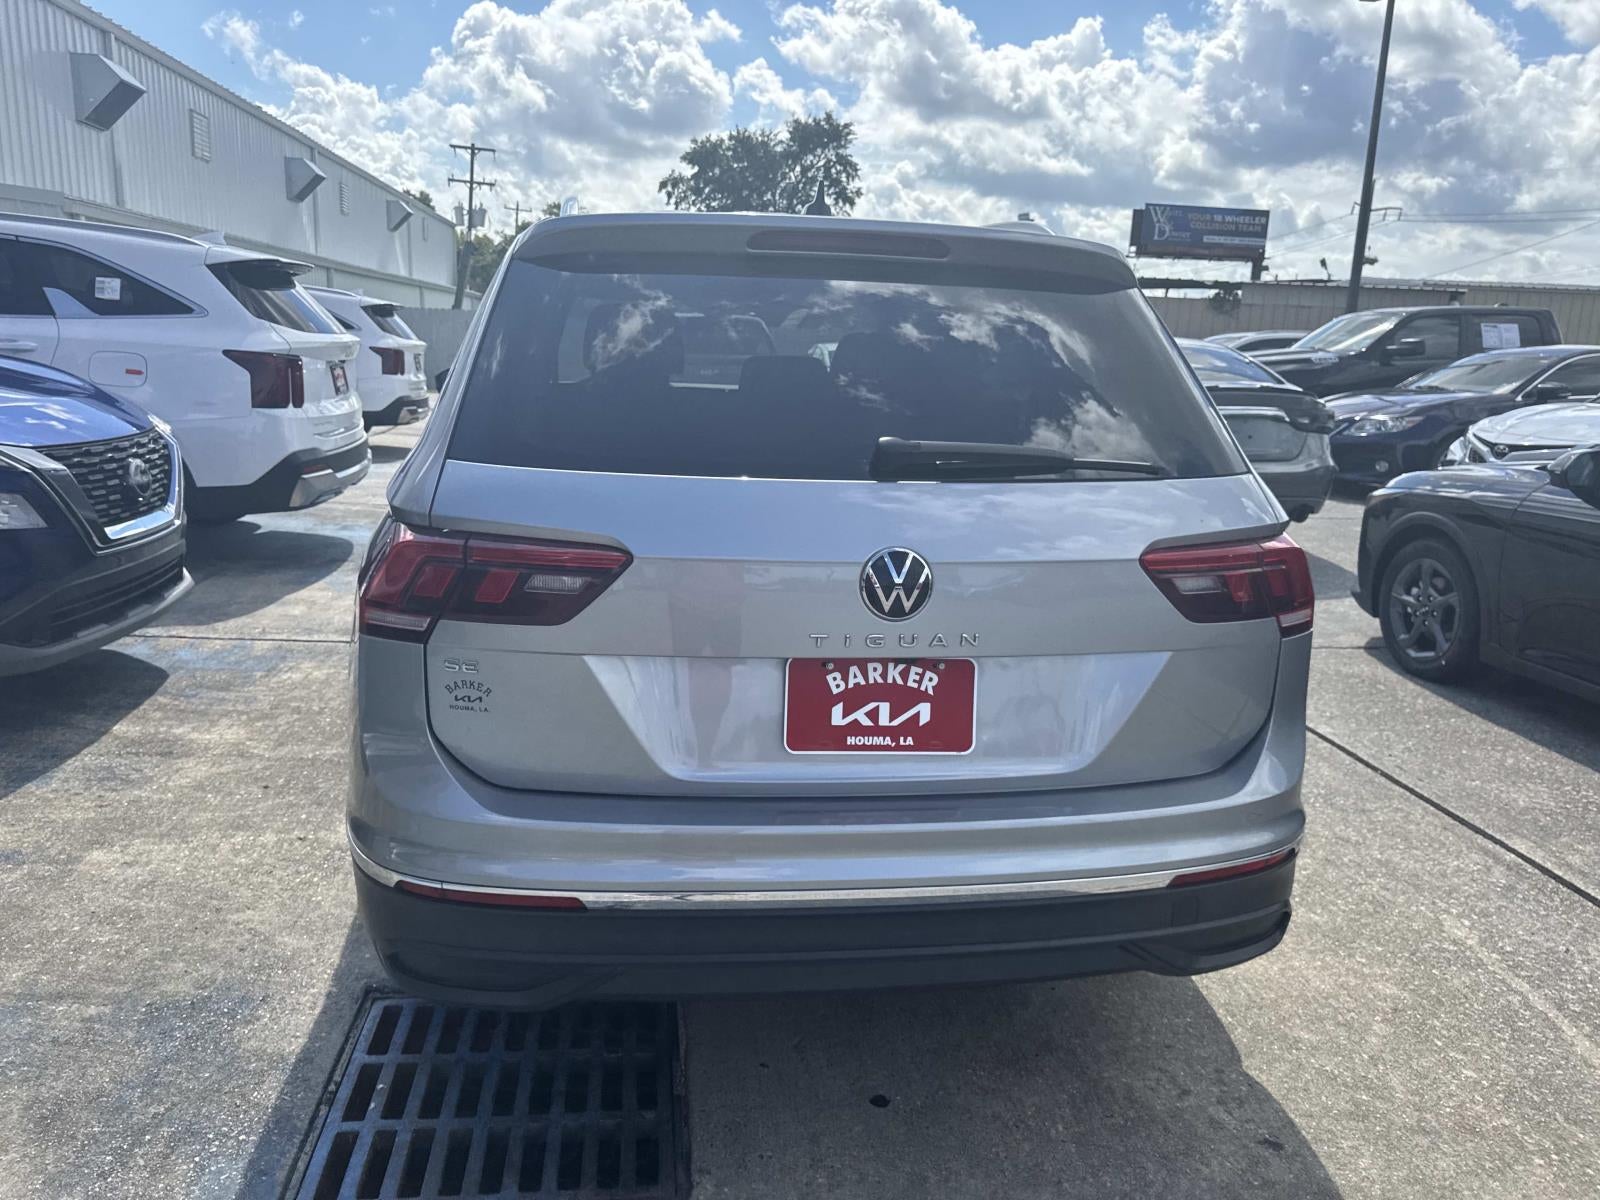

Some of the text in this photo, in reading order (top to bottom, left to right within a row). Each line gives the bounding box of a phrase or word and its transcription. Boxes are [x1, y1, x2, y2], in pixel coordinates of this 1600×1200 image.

[1187, 213, 1212, 221] YOUR
[1225, 215, 1267, 224] WHEELER
[1190, 222, 1262, 233] COLLISION TEAM
[444, 660, 479, 673] SE
[826, 662, 939, 696] BARKER
[445, 680, 492, 697] BARKER
[454, 694, 482, 703] KIA
[831, 701, 932, 727] KIA
[846, 735, 914, 746] HOUMA, LA
